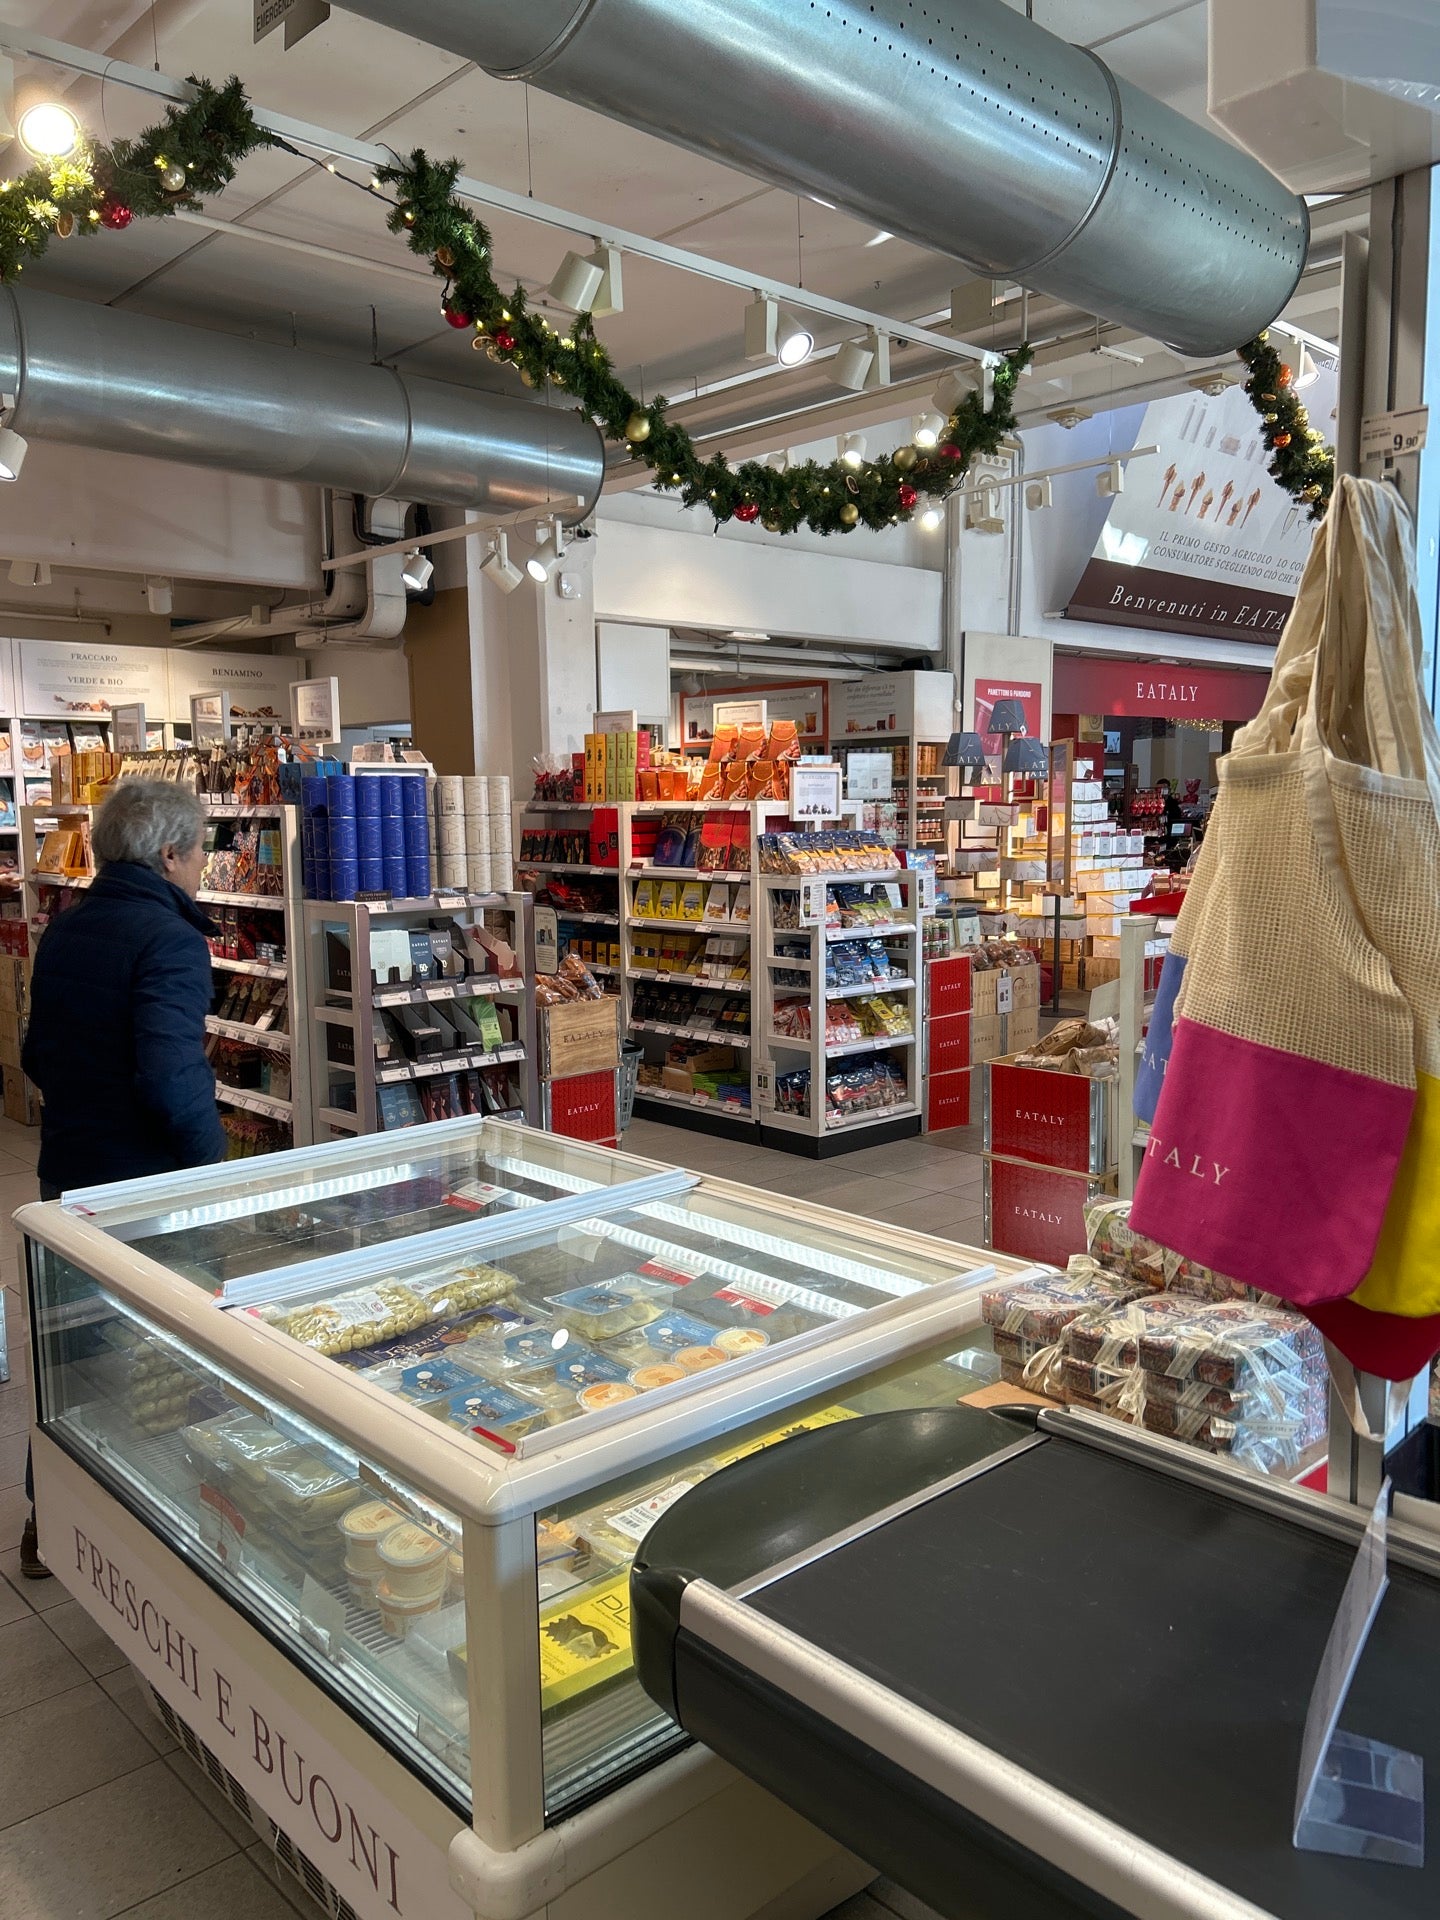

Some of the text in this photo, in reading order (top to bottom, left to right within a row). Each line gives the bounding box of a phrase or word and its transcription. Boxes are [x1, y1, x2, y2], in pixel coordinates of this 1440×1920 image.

[1159, 531, 1169, 541] IL
[1172, 534, 1200, 548] PRIMO
[1203, 541, 1230, 555] GESTO
[1231, 548, 1272, 564] AGRICOLO
[1276, 557, 1288, 568] LO
[1153, 545, 1220, 567] CONSUMATORE
[1214, 559, 1263, 577] SCEGLIENDO
[1263, 569, 1278, 580] CIÒ
[1277, 572, 1294, 584] CHE
[1109, 585, 1207, 618] Benvenuti
[1210, 605, 1227, 621] in
[71, 653, 118, 662] FRACCARO
[67, 676, 98, 685] VERDE
[107, 678, 123, 686] BIO
[212, 668, 263, 679] BENIAMINO
[1136, 682, 1199, 703] EATALY
[940, 982, 961, 992] EATALY
[562, 1029, 605, 1043] EATALY
[939, 1039, 960, 1049] EATALY
[938, 1096, 960, 1105] EATALY
[567, 1102, 600, 1116] EATALY
[1015, 1109, 1066, 1126] EATALY
[1014, 1206, 1063, 1225] EATALY
[382, 1324, 451, 1359] TORTELLINI
[72, 1525, 403, 1917] FRESCHI E BUONI
